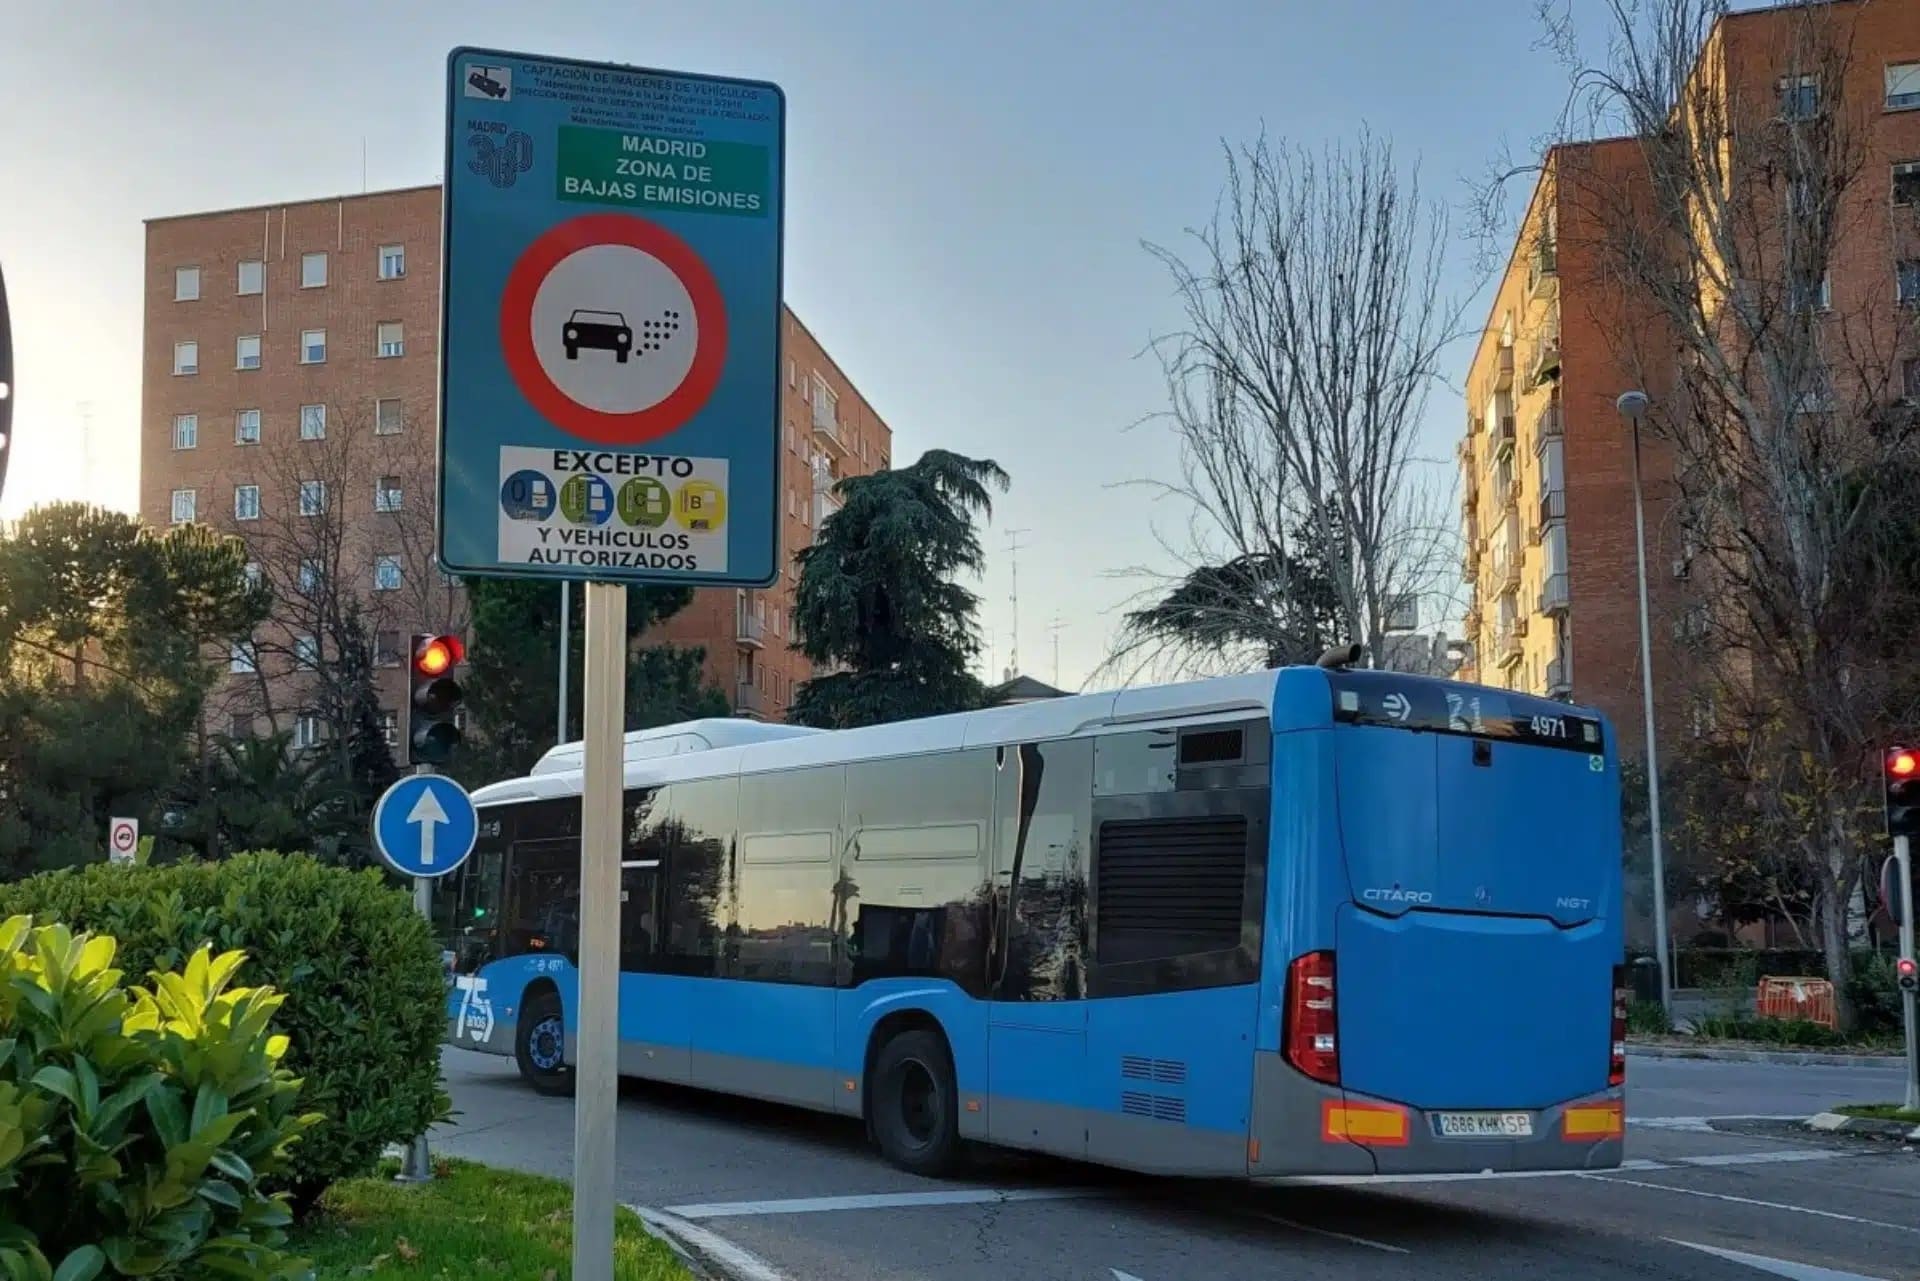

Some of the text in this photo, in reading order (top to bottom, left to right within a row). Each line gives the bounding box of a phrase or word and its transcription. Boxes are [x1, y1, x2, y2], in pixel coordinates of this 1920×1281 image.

[593, 72, 609, 84] DE
[675, 82, 690, 93] DE
[467, 119, 508, 134] MADRID
[621, 134, 707, 159] MADRID
[616, 158, 712, 183] ZONA DE
[564, 177, 761, 209] BAJAS EMISIONES
[553, 450, 694, 478] EXCEPTO
[634, 492, 647, 507] C
[690, 495, 702, 509] B
[537, 525, 690, 550] Y VEHÍCULOS
[528, 547, 698, 571] AUTORIZADOS
[1530, 715, 1567, 738] 4971
[1362, 888, 1433, 904] CITARO
[1555, 896, 1591, 910] NGT
[456, 975, 495, 1043] 75
[1442, 1115, 1475, 1133] 2686
[1505, 1115, 1527, 1133] SP
